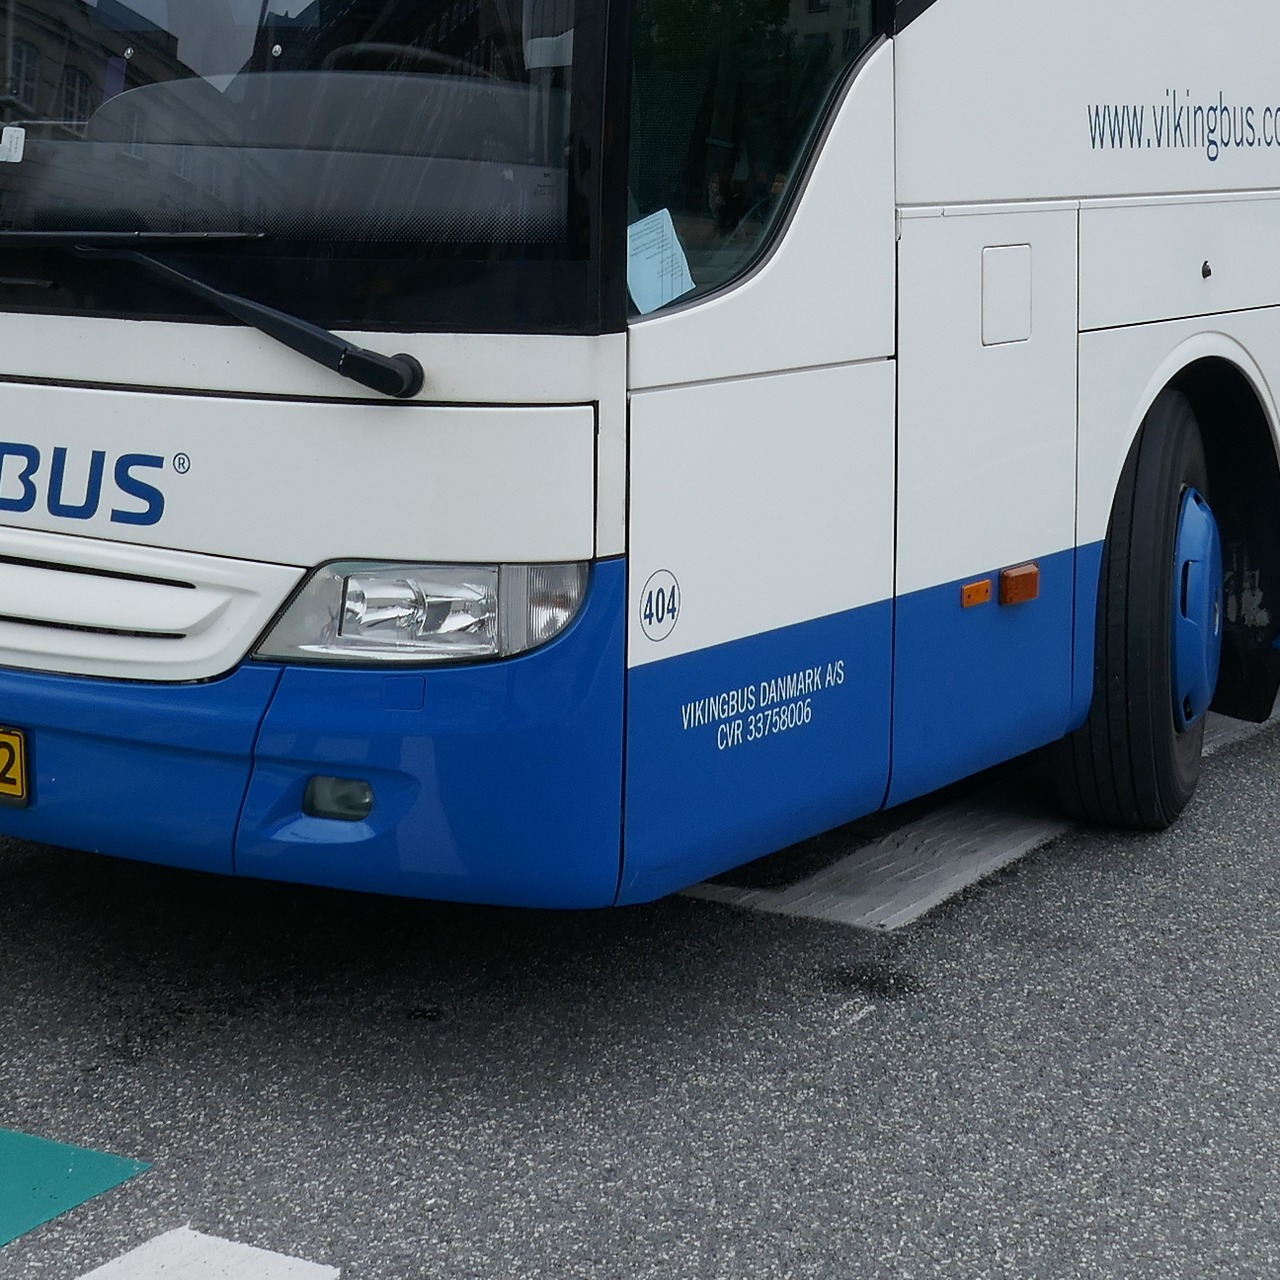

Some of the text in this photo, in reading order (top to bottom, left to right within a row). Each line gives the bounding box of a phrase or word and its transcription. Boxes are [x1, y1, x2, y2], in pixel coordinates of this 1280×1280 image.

[643, 585, 677, 625] 404
[681, 660, 844, 730] VIKINGBUS DANMARK A/S
[717, 698, 812, 750] CVR 33758006
